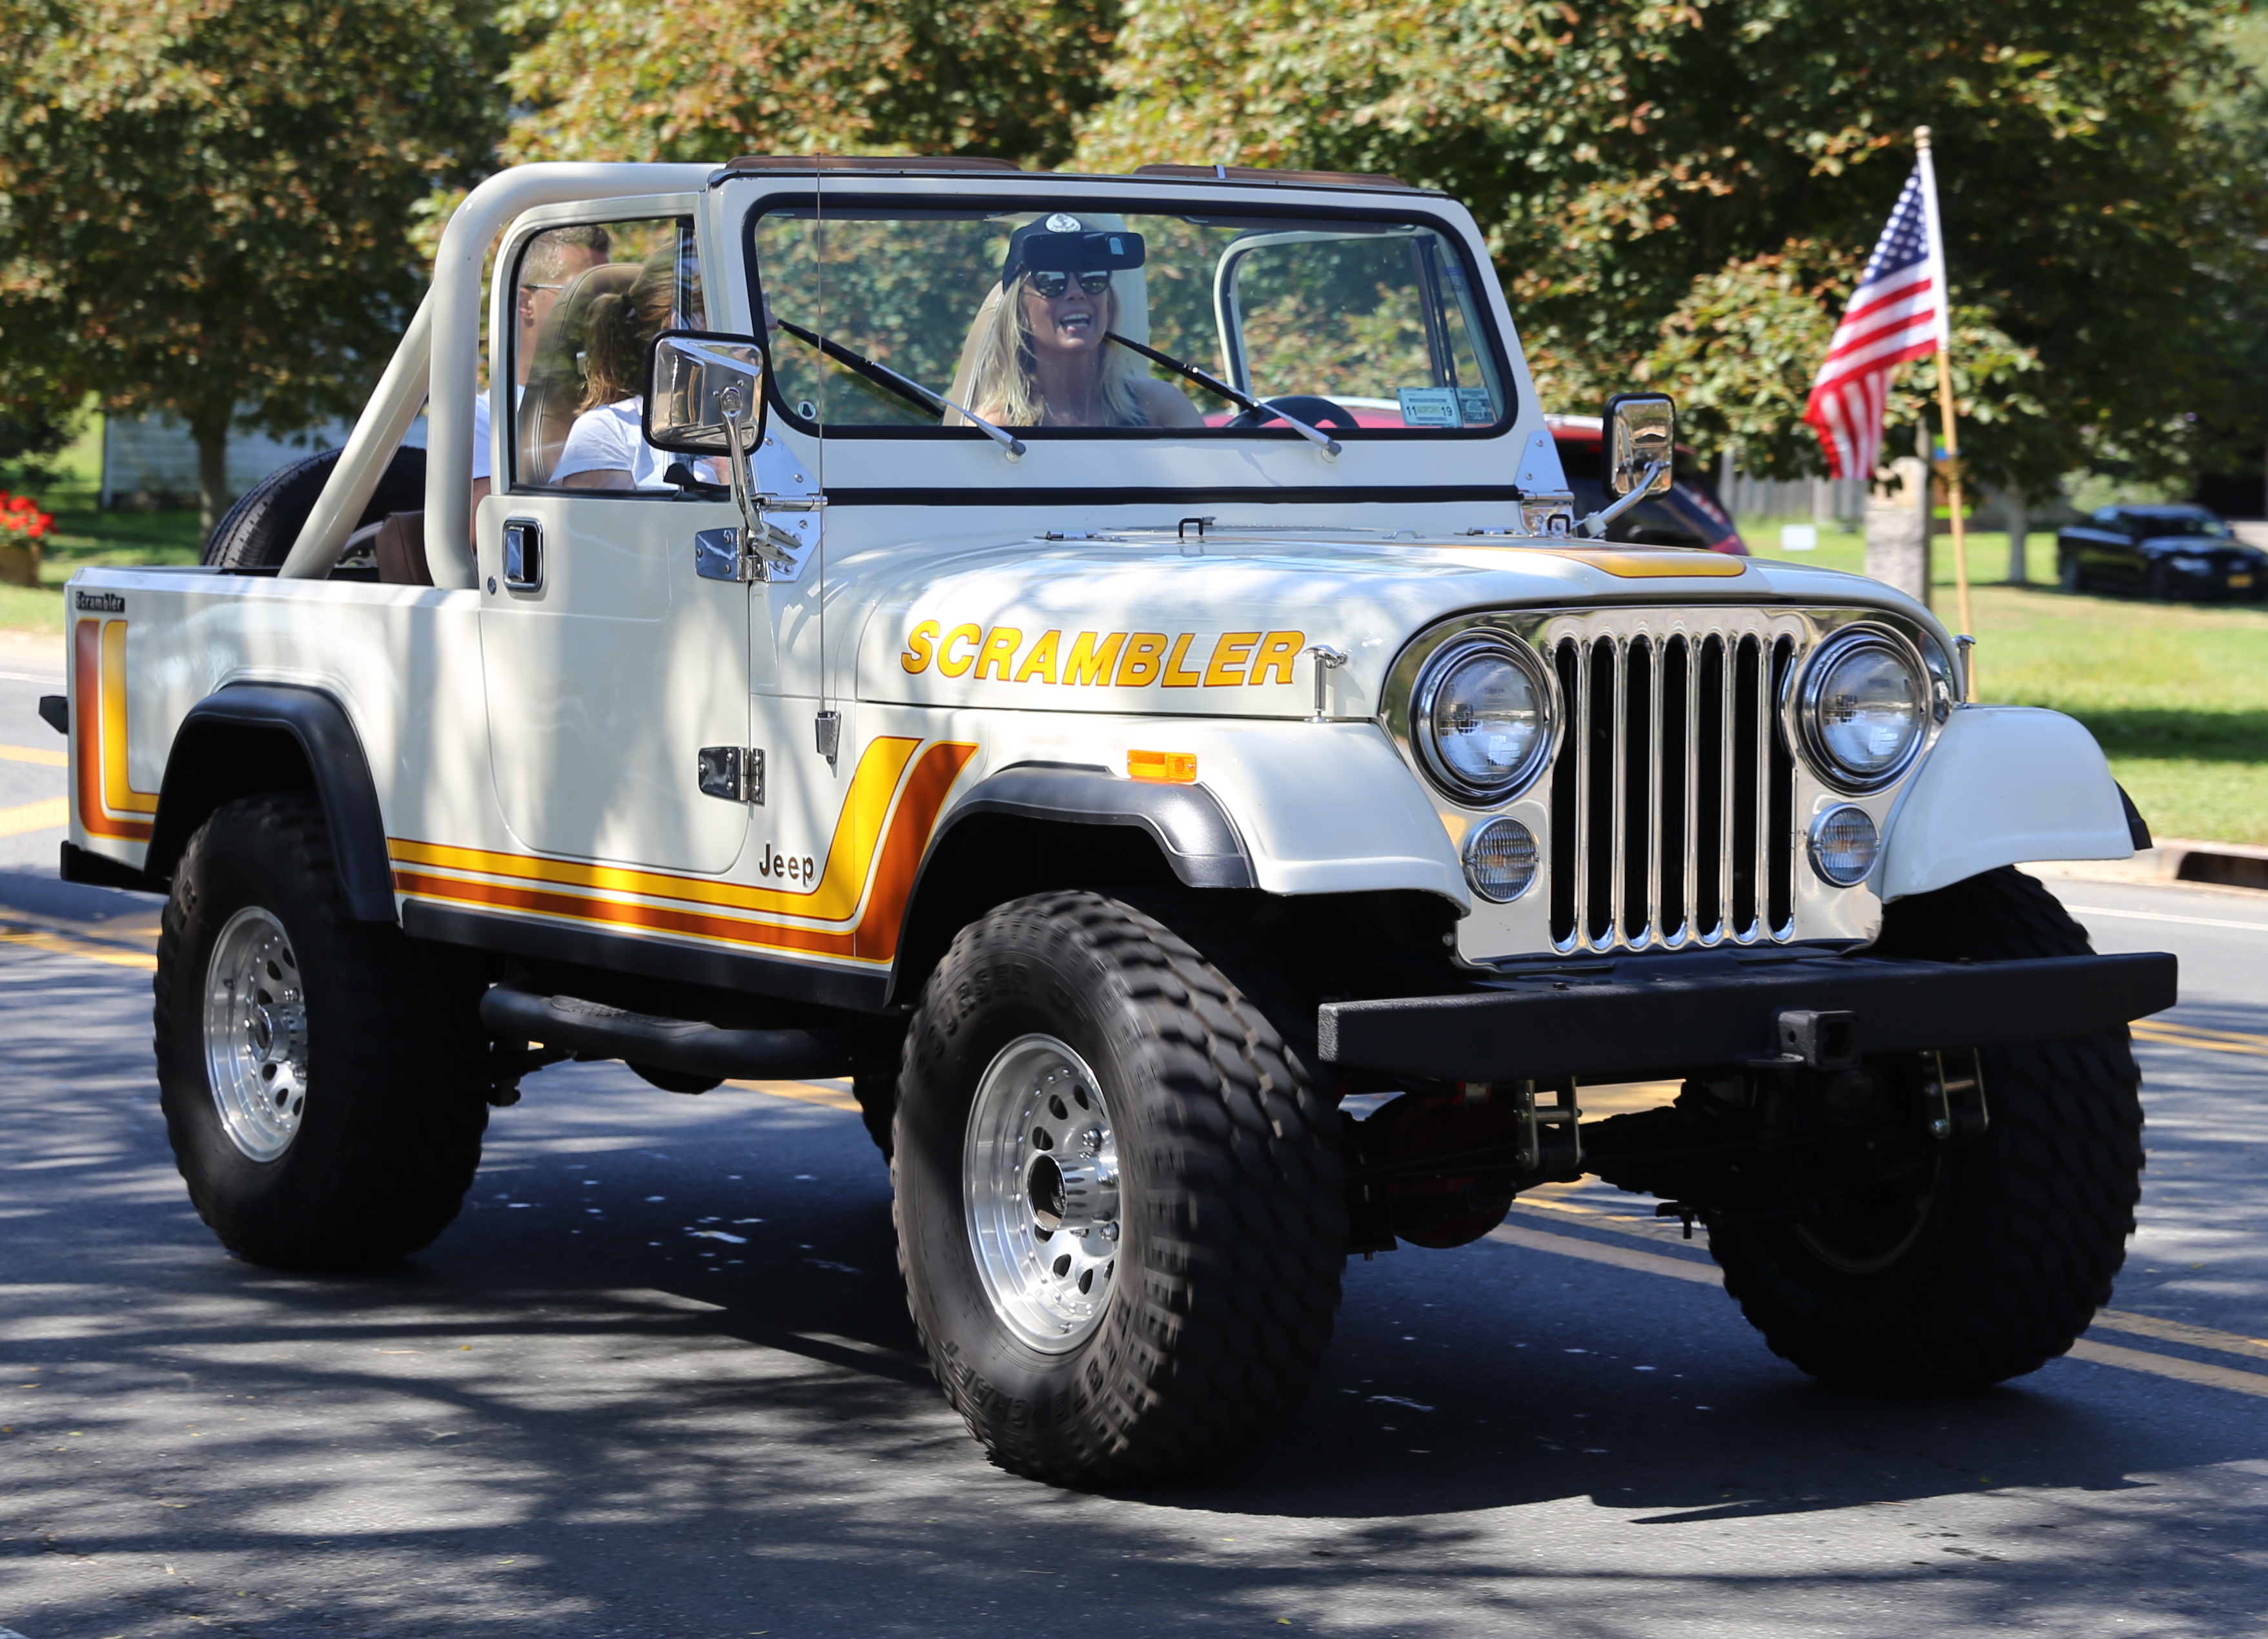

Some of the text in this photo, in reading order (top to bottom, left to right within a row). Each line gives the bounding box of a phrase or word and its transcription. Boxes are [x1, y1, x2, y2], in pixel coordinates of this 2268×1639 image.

[1406, 406, 1452, 417] 11 19
[76, 592, 125, 612] Scrambler
[901, 620, 1305, 688] SCRAMBLER
[759, 843, 815, 887] Jeep
